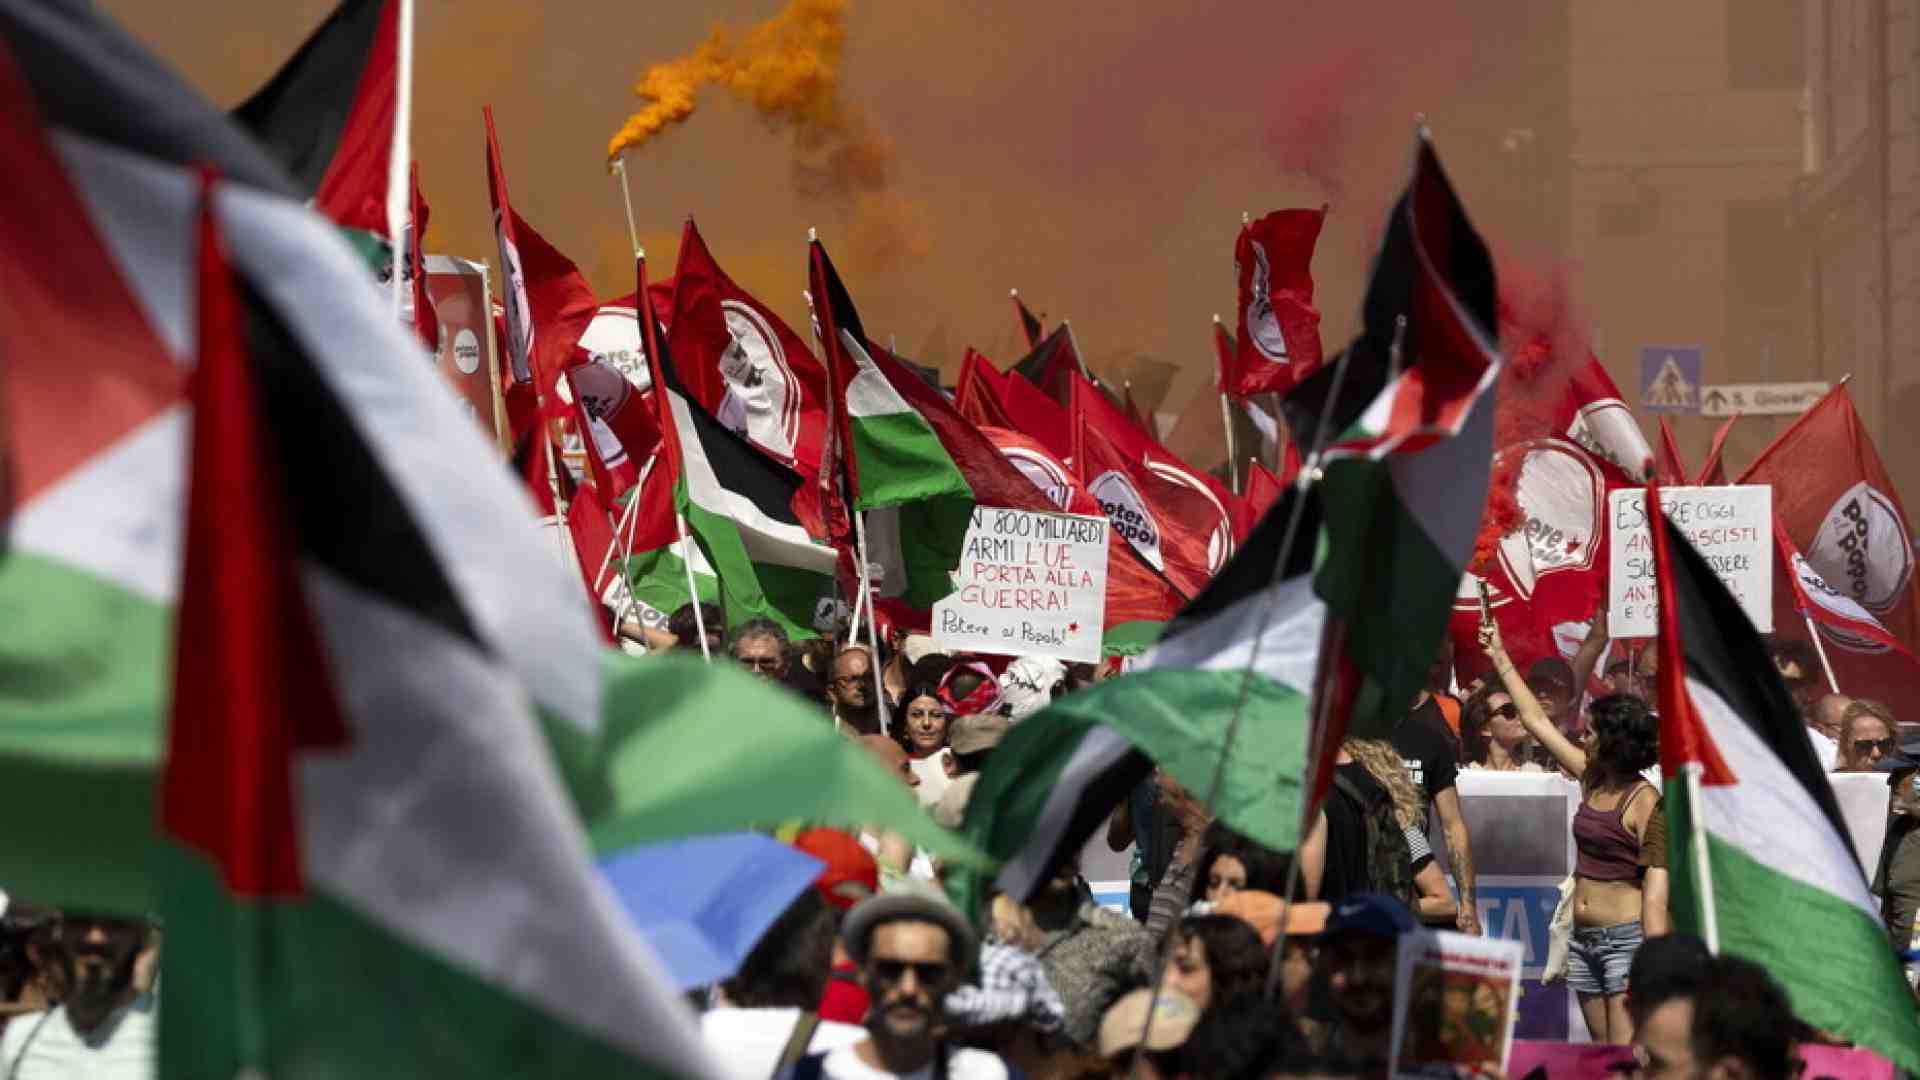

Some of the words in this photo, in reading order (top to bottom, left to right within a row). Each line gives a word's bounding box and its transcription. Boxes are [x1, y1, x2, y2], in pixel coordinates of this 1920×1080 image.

[994, 511, 1030, 537] 800
[1096, 498, 1149, 530] oter
[1617, 498, 1691, 529] ESRE
[1696, 502, 1735, 520] OGGI
[967, 536, 1015, 562] ARMI
[973, 562, 1036, 585] PORTA
[1046, 571, 1093, 587] ALLA
[961, 584, 1069, 610] GUERRA!
[942, 609, 989, 635] Potere
